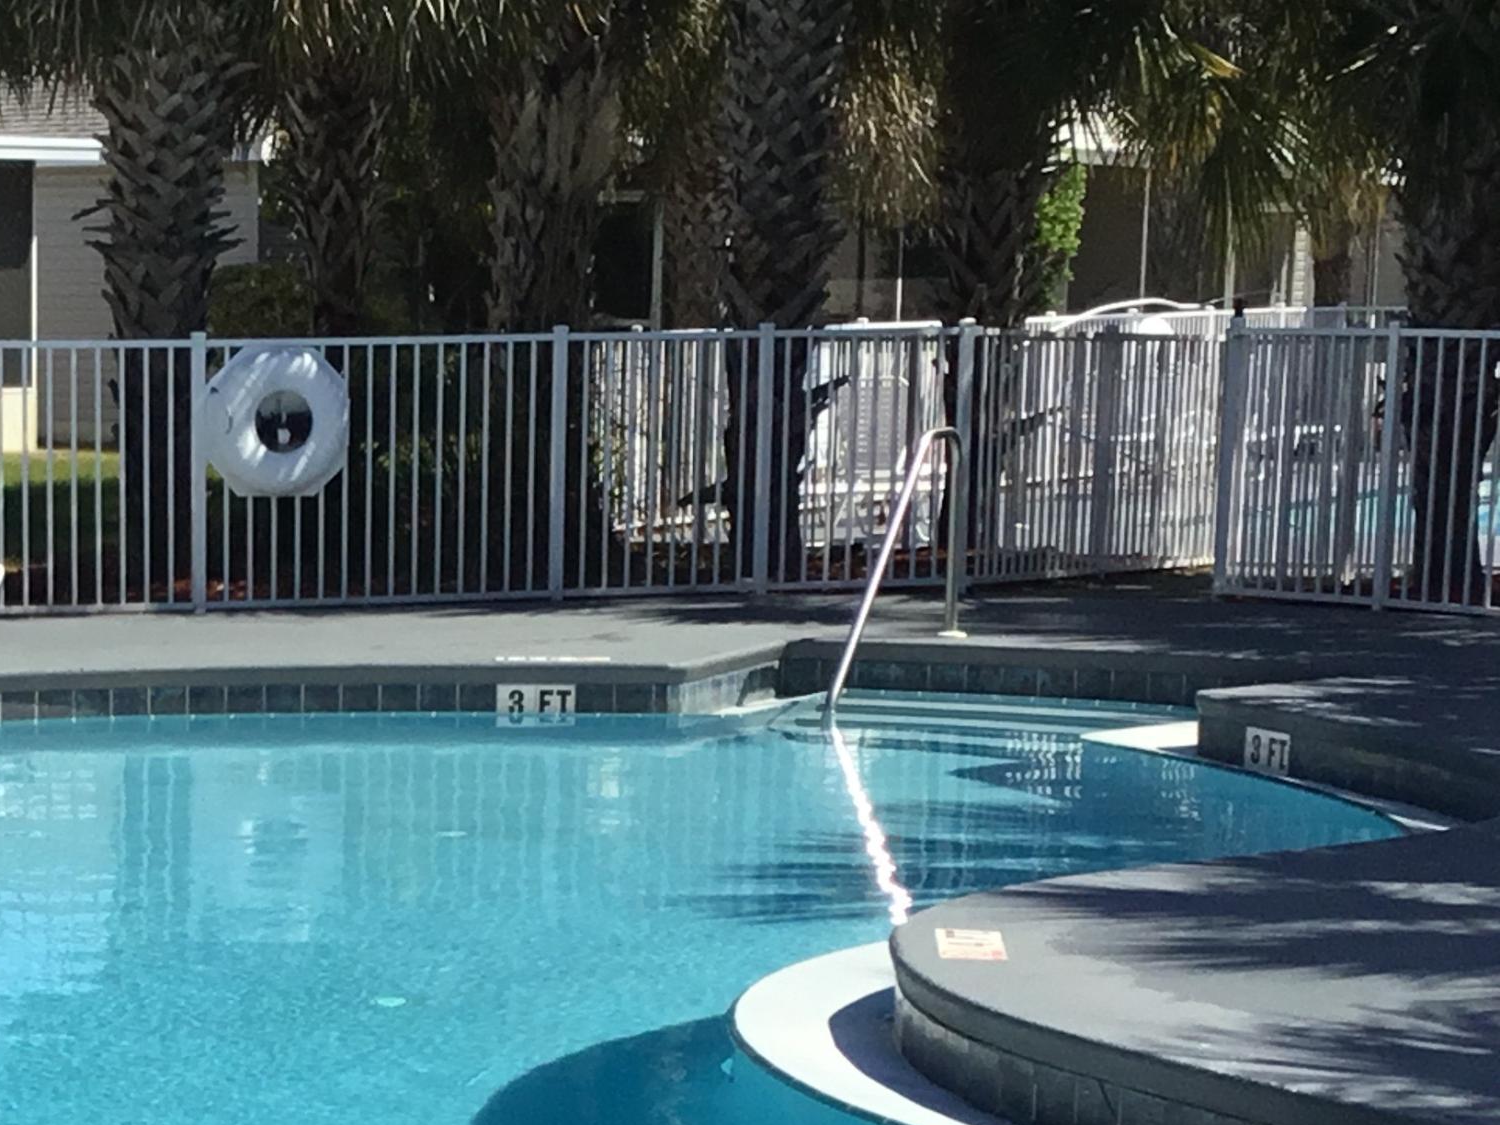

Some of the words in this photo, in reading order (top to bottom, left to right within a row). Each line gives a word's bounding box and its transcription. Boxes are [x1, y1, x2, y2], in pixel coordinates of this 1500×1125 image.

[508, 690, 524, 714] 3
[539, 690, 571, 714] FT
[1250, 734, 1262, 764] 3
